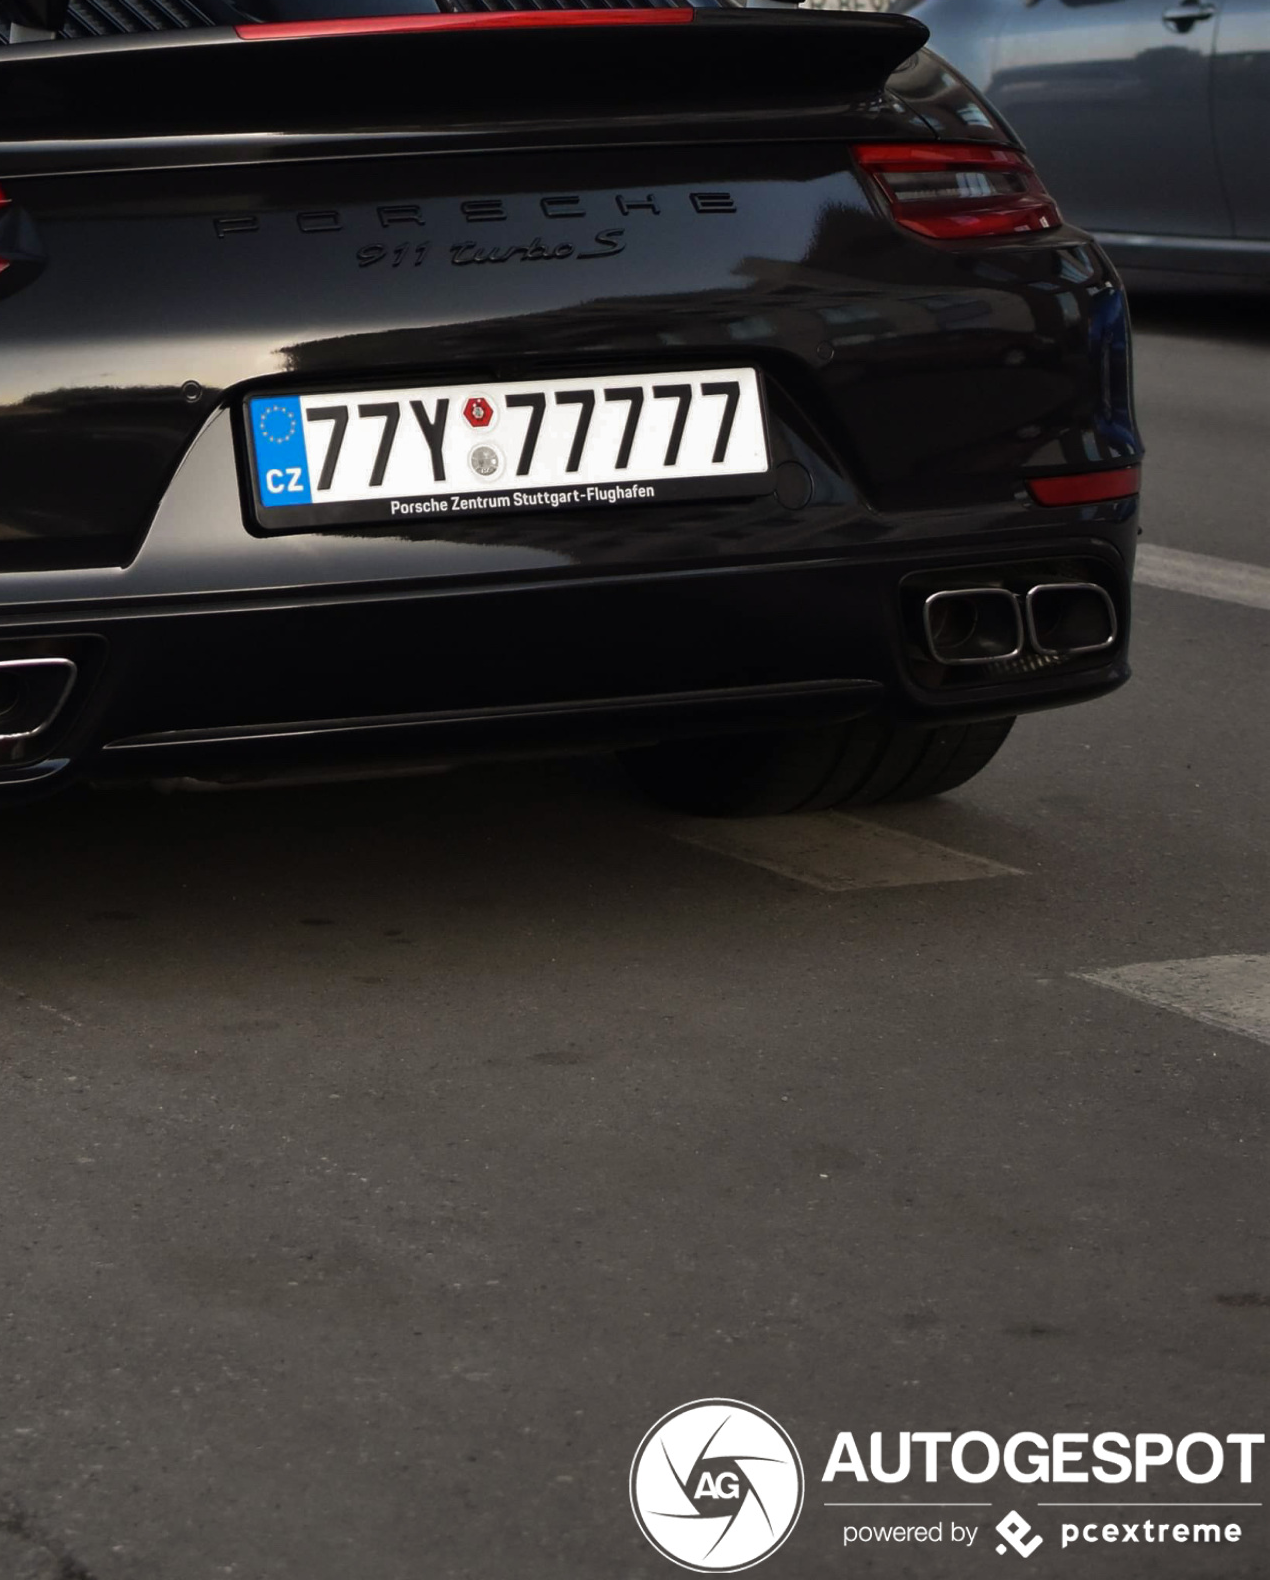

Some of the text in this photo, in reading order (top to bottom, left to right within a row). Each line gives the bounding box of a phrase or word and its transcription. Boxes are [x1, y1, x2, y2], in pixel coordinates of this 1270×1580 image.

[213, 191, 738, 239] PORSCHE
[356, 241, 430, 268] 911
[306, 380, 741, 491] 77Y 77777
[266, 467, 304, 494] CZ
[390, 484, 656, 515] Porsche Zentrum Stuttgart-Flughafen
